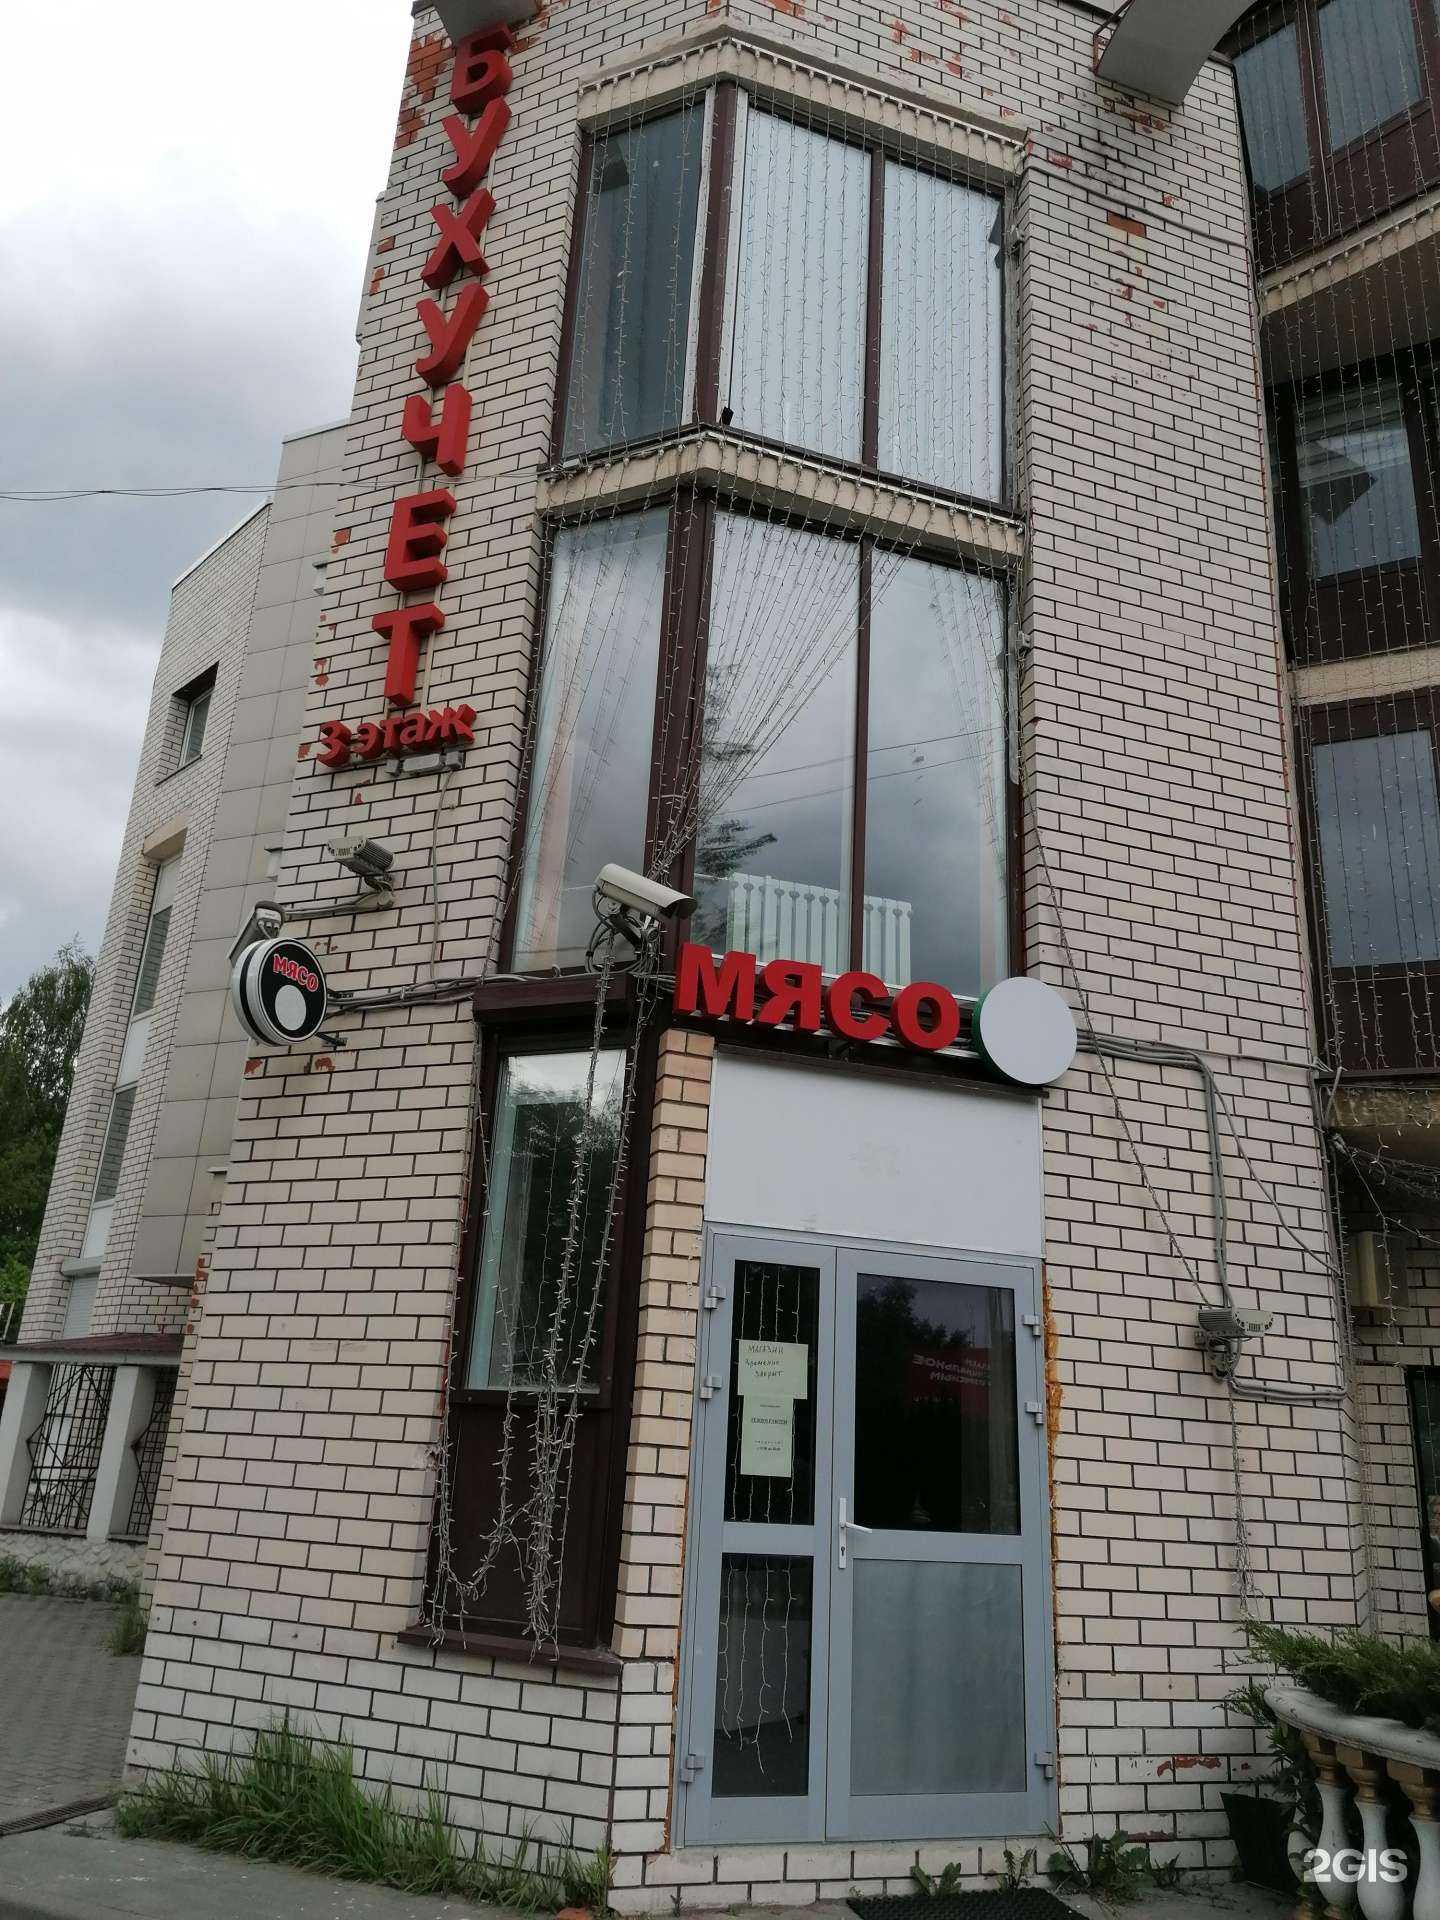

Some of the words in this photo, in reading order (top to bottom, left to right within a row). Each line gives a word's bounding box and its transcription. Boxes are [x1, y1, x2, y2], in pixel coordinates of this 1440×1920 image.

[372, 22, 514, 707] БУХУЧЕТ
[316, 720, 351, 768] 3
[351, 703, 477, 760] этаж
